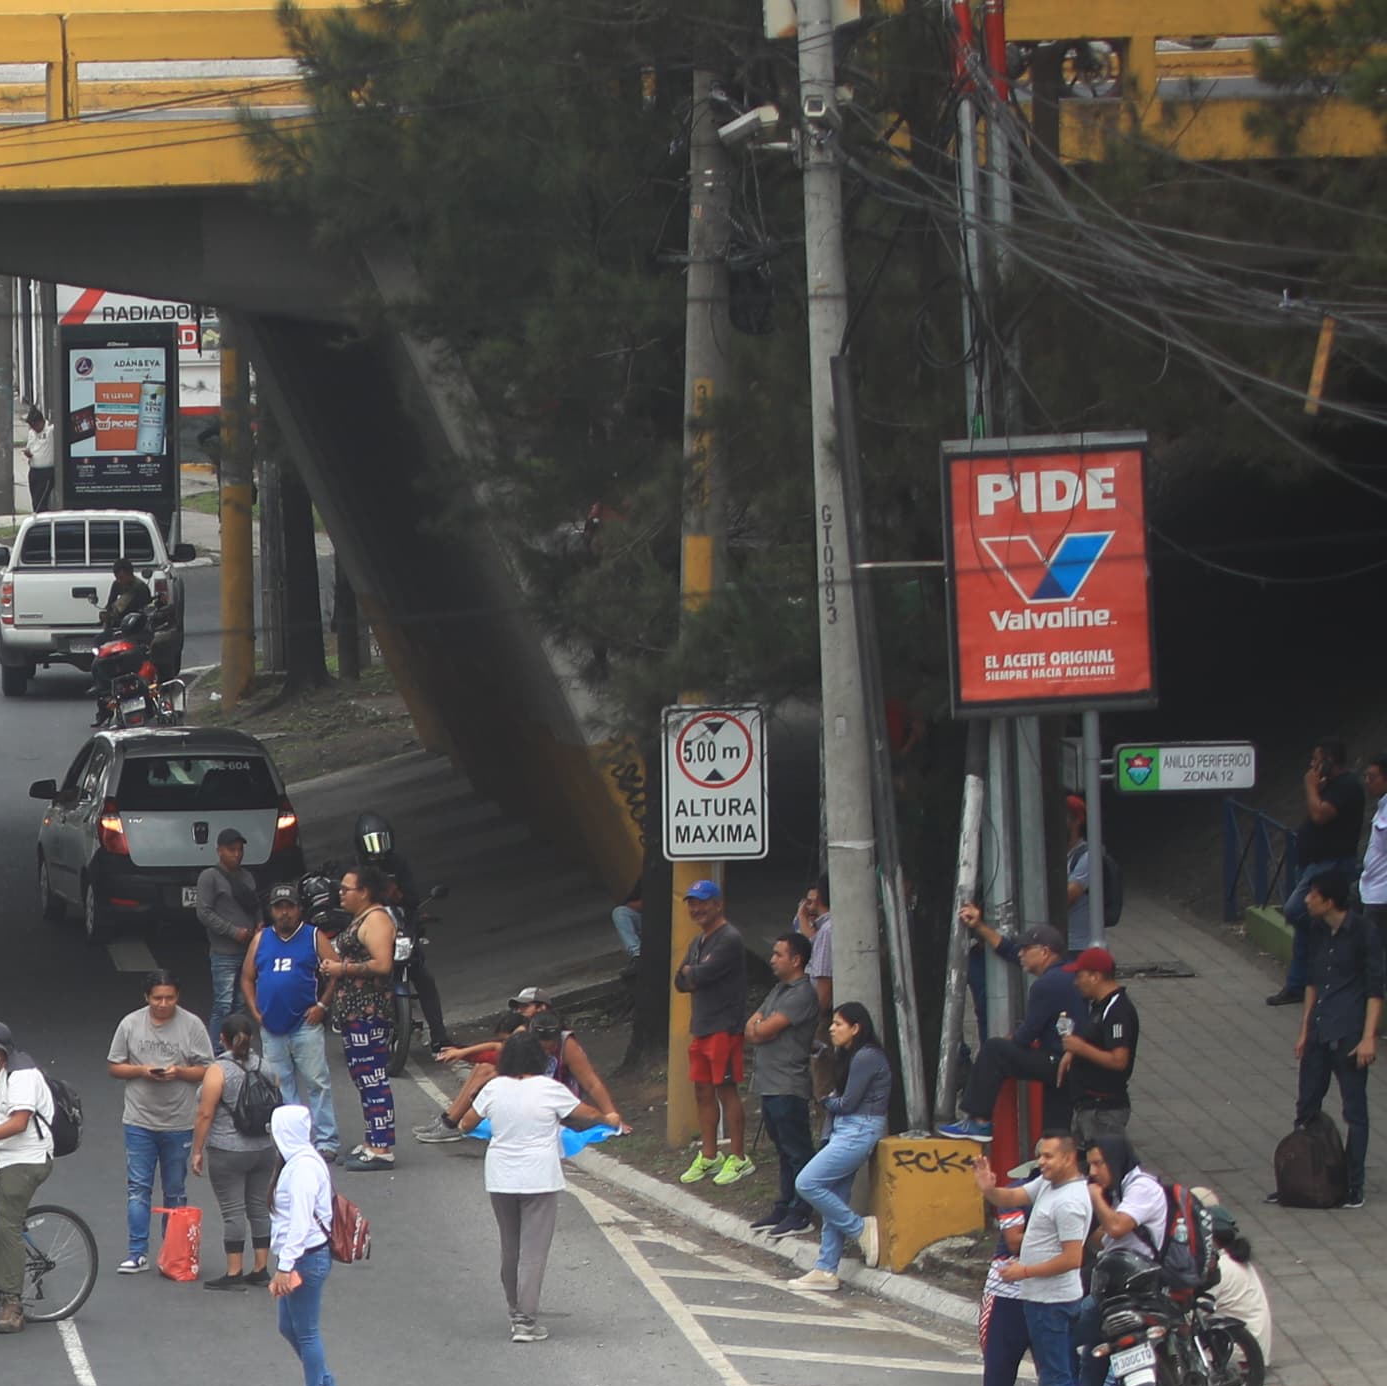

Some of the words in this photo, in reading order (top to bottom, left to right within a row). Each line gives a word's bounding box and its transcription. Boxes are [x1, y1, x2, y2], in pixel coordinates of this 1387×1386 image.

[977, 467, 1116, 516] PIDE
[989, 606, 1111, 632] Valvoline
[985, 655, 999, 669] EL
[1003, 652, 1046, 668] ACEITE
[1049, 649, 1115, 665] ORIGINAL
[985, 669, 1028, 681] SIEMPRE
[1031, 667, 1062, 679] HACIA
[1065, 664, 1115, 677] ADELANTE
[683, 740, 716, 763] 5.00
[722, 745, 740, 759] m
[1163, 753, 1196, 769] ANILLO
[1196, 753, 1251, 768] PERIFERICO
[1183, 771, 1219, 783] ZONA
[1221, 770, 1234, 782] 12
[675, 798, 757, 817] ALTURA
[675, 824, 757, 844] MAXIMA
[273, 958, 292, 972] 12
